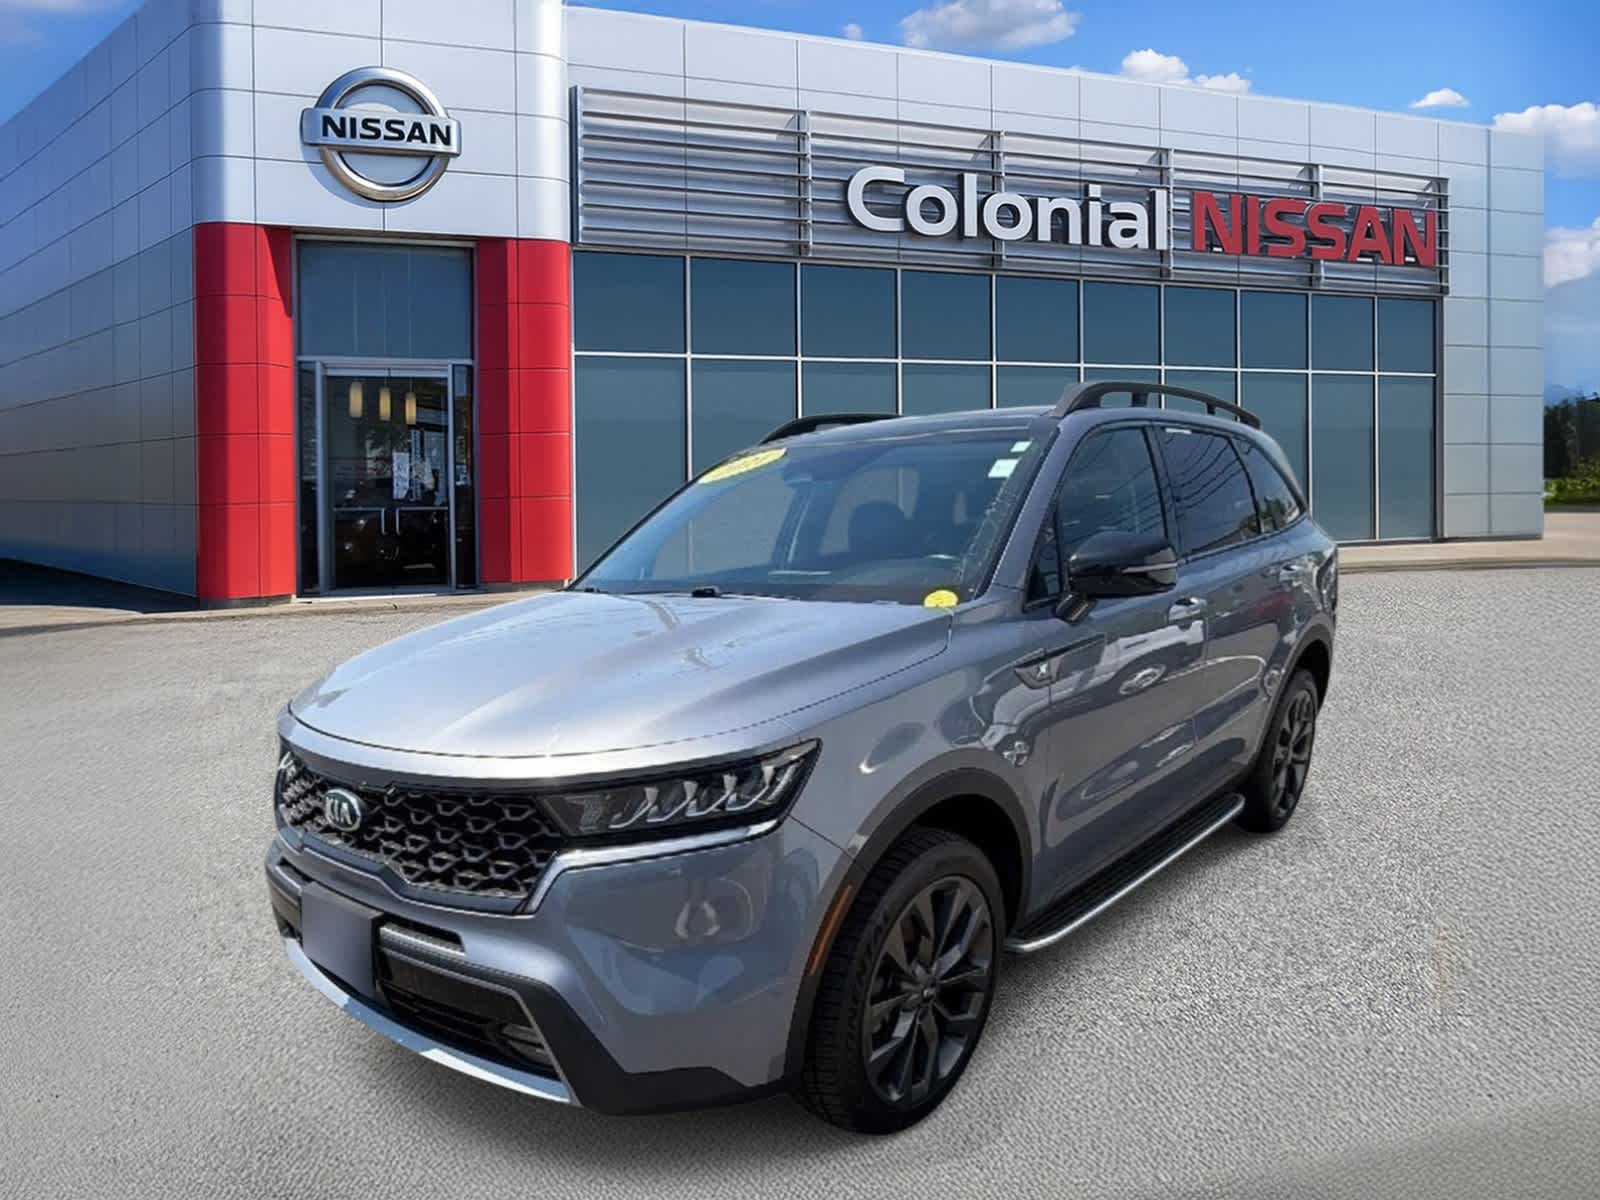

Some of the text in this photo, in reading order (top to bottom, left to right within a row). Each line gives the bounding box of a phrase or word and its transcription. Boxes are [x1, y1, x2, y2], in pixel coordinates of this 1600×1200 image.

[322, 115, 451, 146] NISSAN
[847, 166, 1437, 267] Colonial NISSAN
